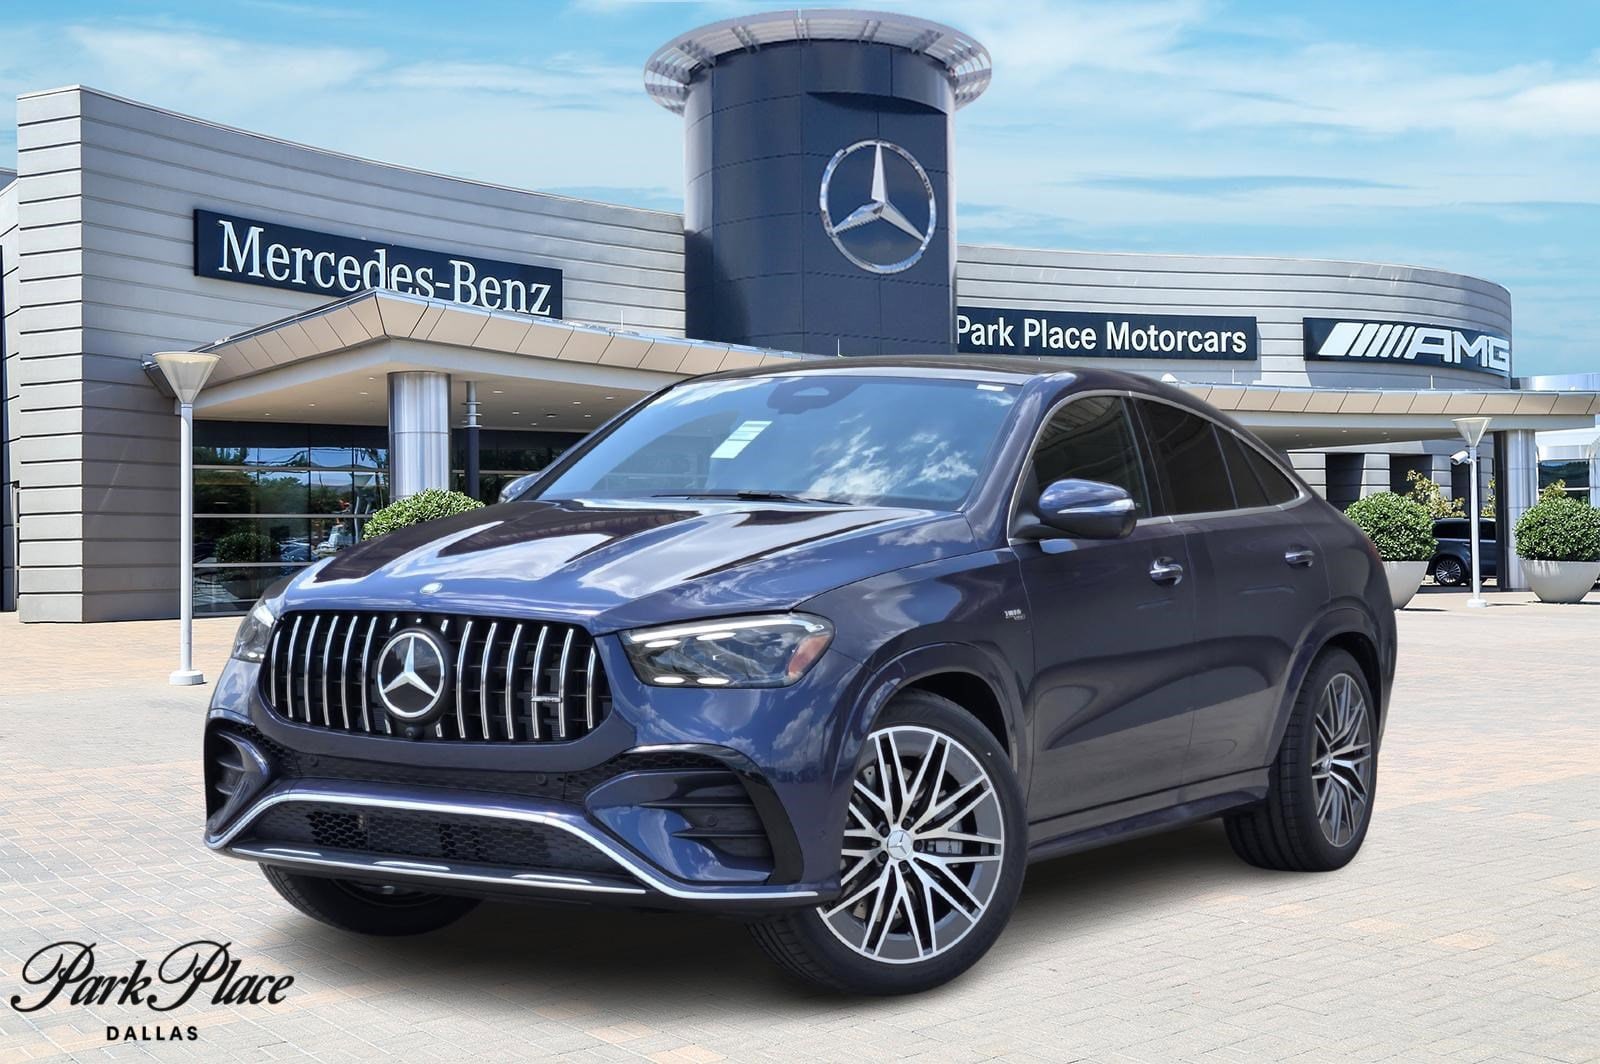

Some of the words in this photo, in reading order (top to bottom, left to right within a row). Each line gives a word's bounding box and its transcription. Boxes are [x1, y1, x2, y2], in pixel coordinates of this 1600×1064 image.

[218, 219, 552, 316] Mercedes-Benz
[957, 315, 1014, 347] Park
[1023, 318, 1097, 350] Place
[1106, 320, 1247, 353] Motorcars
[1403, 327, 1510, 373] AMG
